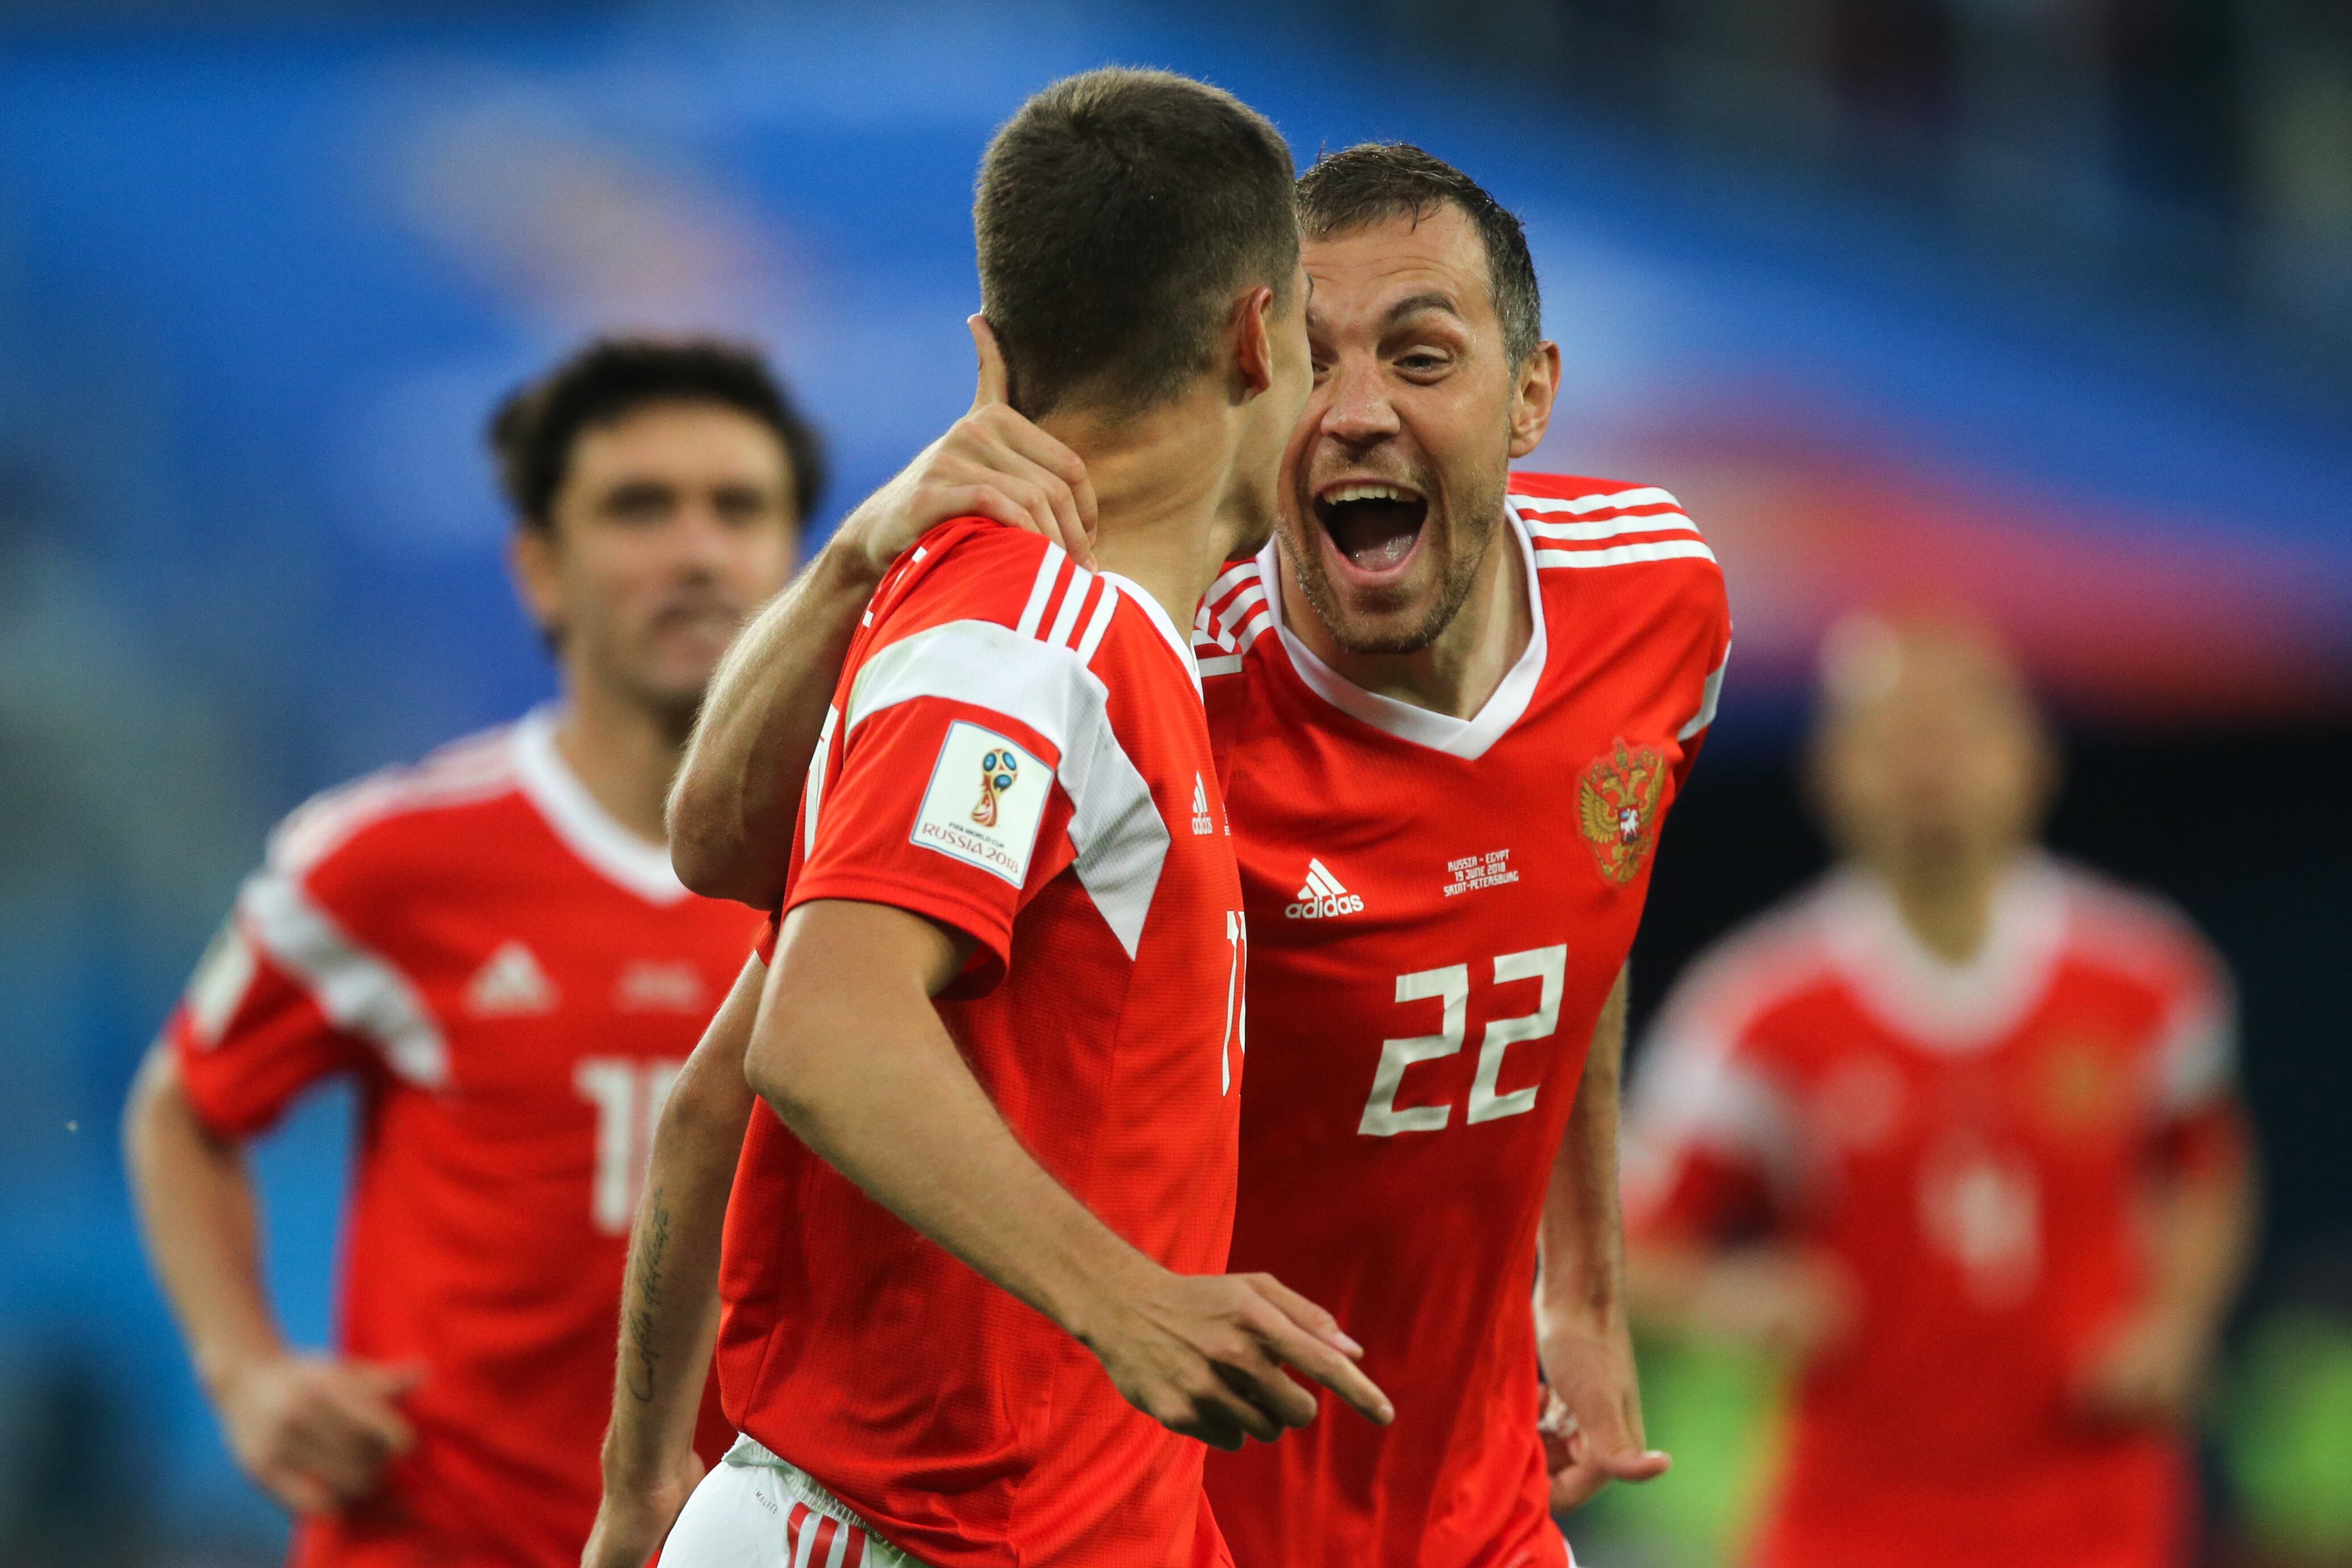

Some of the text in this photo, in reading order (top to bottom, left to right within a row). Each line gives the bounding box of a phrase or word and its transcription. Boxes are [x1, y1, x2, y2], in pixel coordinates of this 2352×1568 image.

[1192, 813, 1212, 835] adidas
[923, 823, 1019, 874] RUSSIA 2018
[965, 829, 991, 842] WORLD
[992, 839, 1005, 847] CUP
[1448, 856, 1478, 872] RUSSIA
[1485, 849, 1510, 863] EGYPT
[1455, 862, 1506, 882] 19 JUNE 2018
[1443, 870, 1519, 897] SAINT-PETERSBURG
[1285, 894, 1365, 919] adidas
[1357, 944, 1568, 1136] 22
